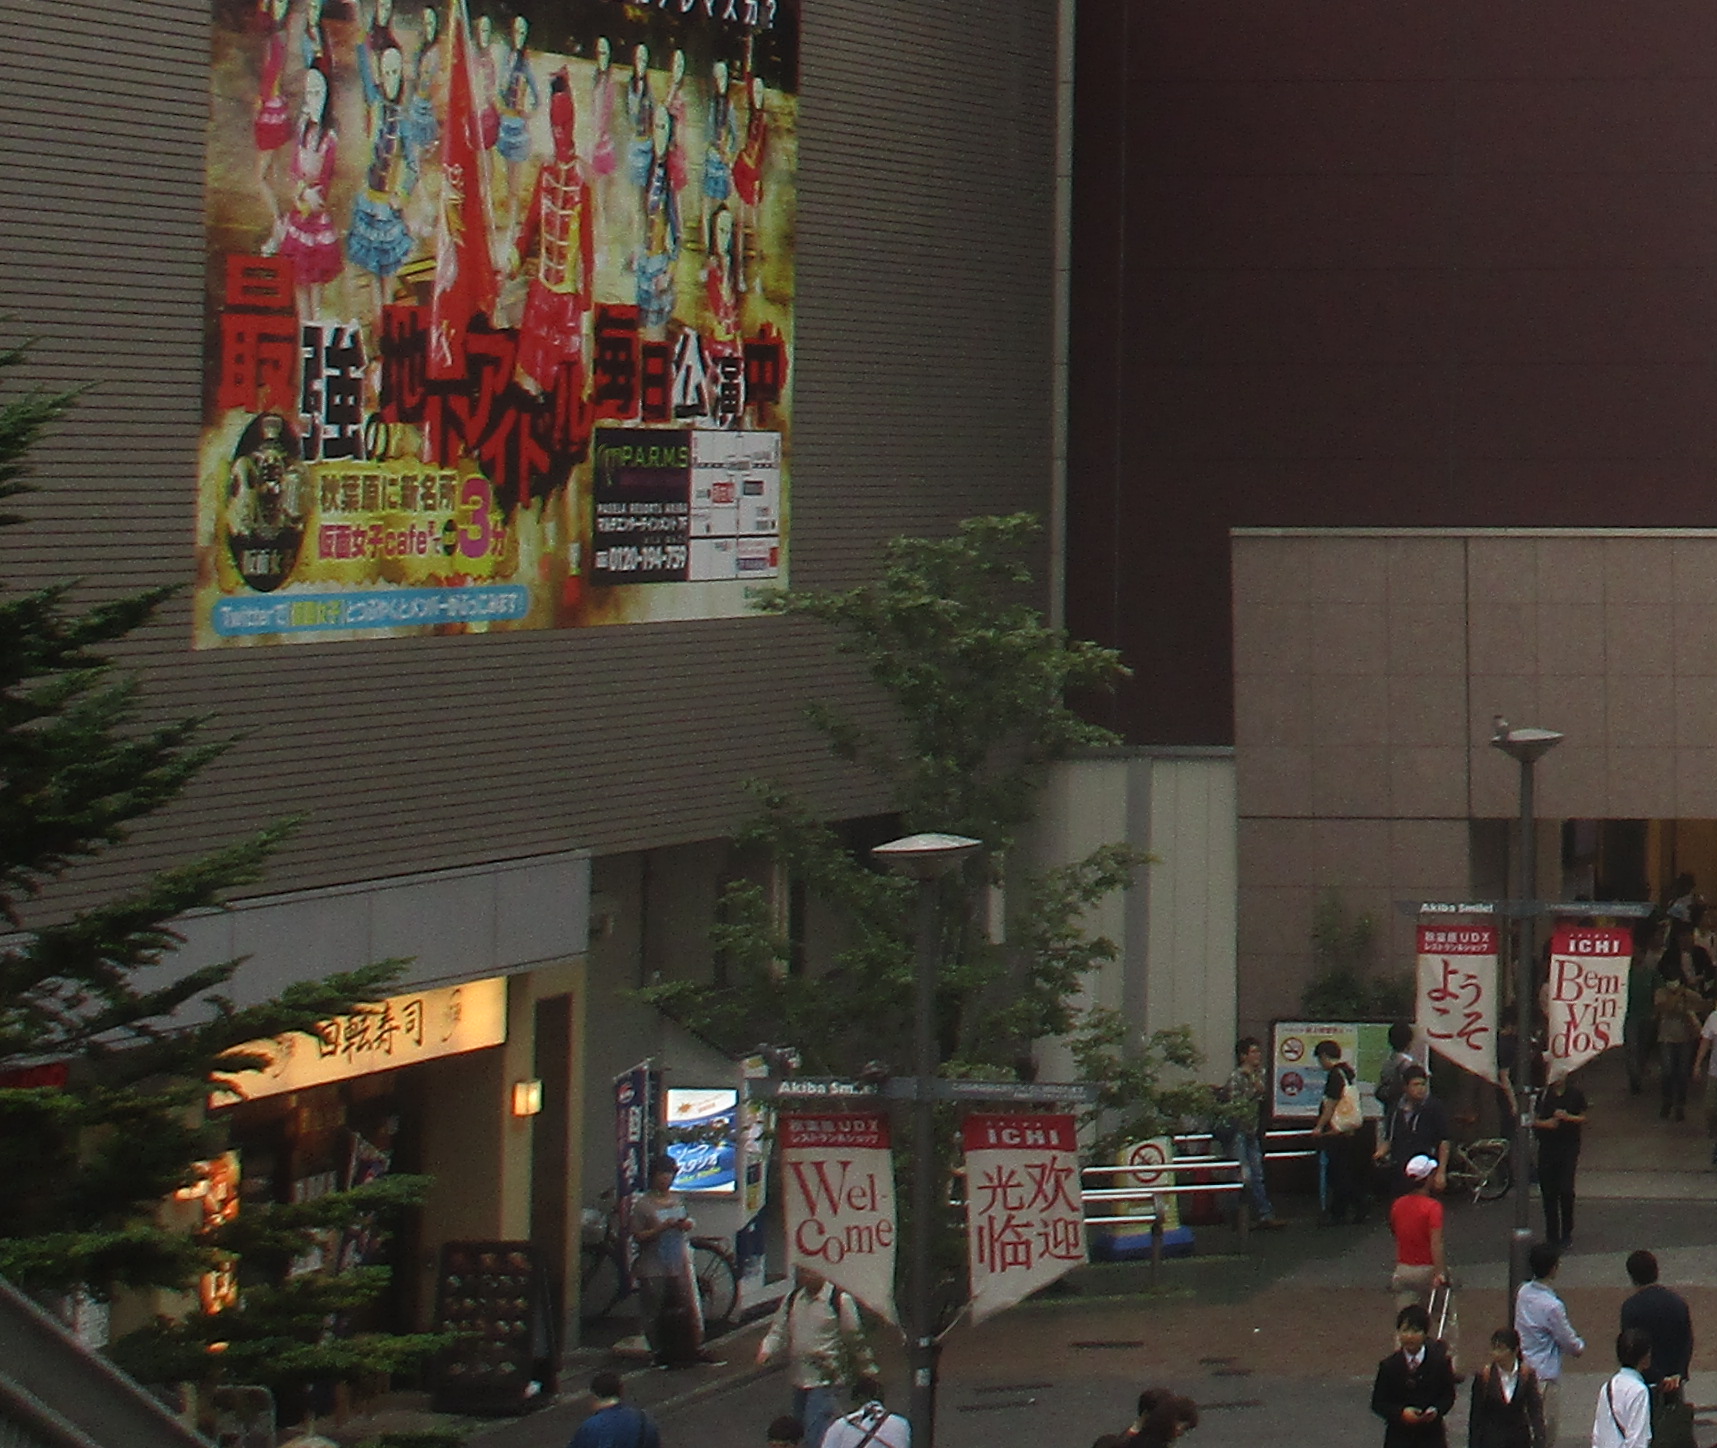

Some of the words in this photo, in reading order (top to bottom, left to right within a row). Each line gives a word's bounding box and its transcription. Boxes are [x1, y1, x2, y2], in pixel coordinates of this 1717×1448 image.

[1420, 903, 1456, 913] Akiba
[1568, 939, 1620, 953] ICHI
[778, 1081, 826, 1093] Akiba
[987, 1129, 1060, 1145] ICHI
